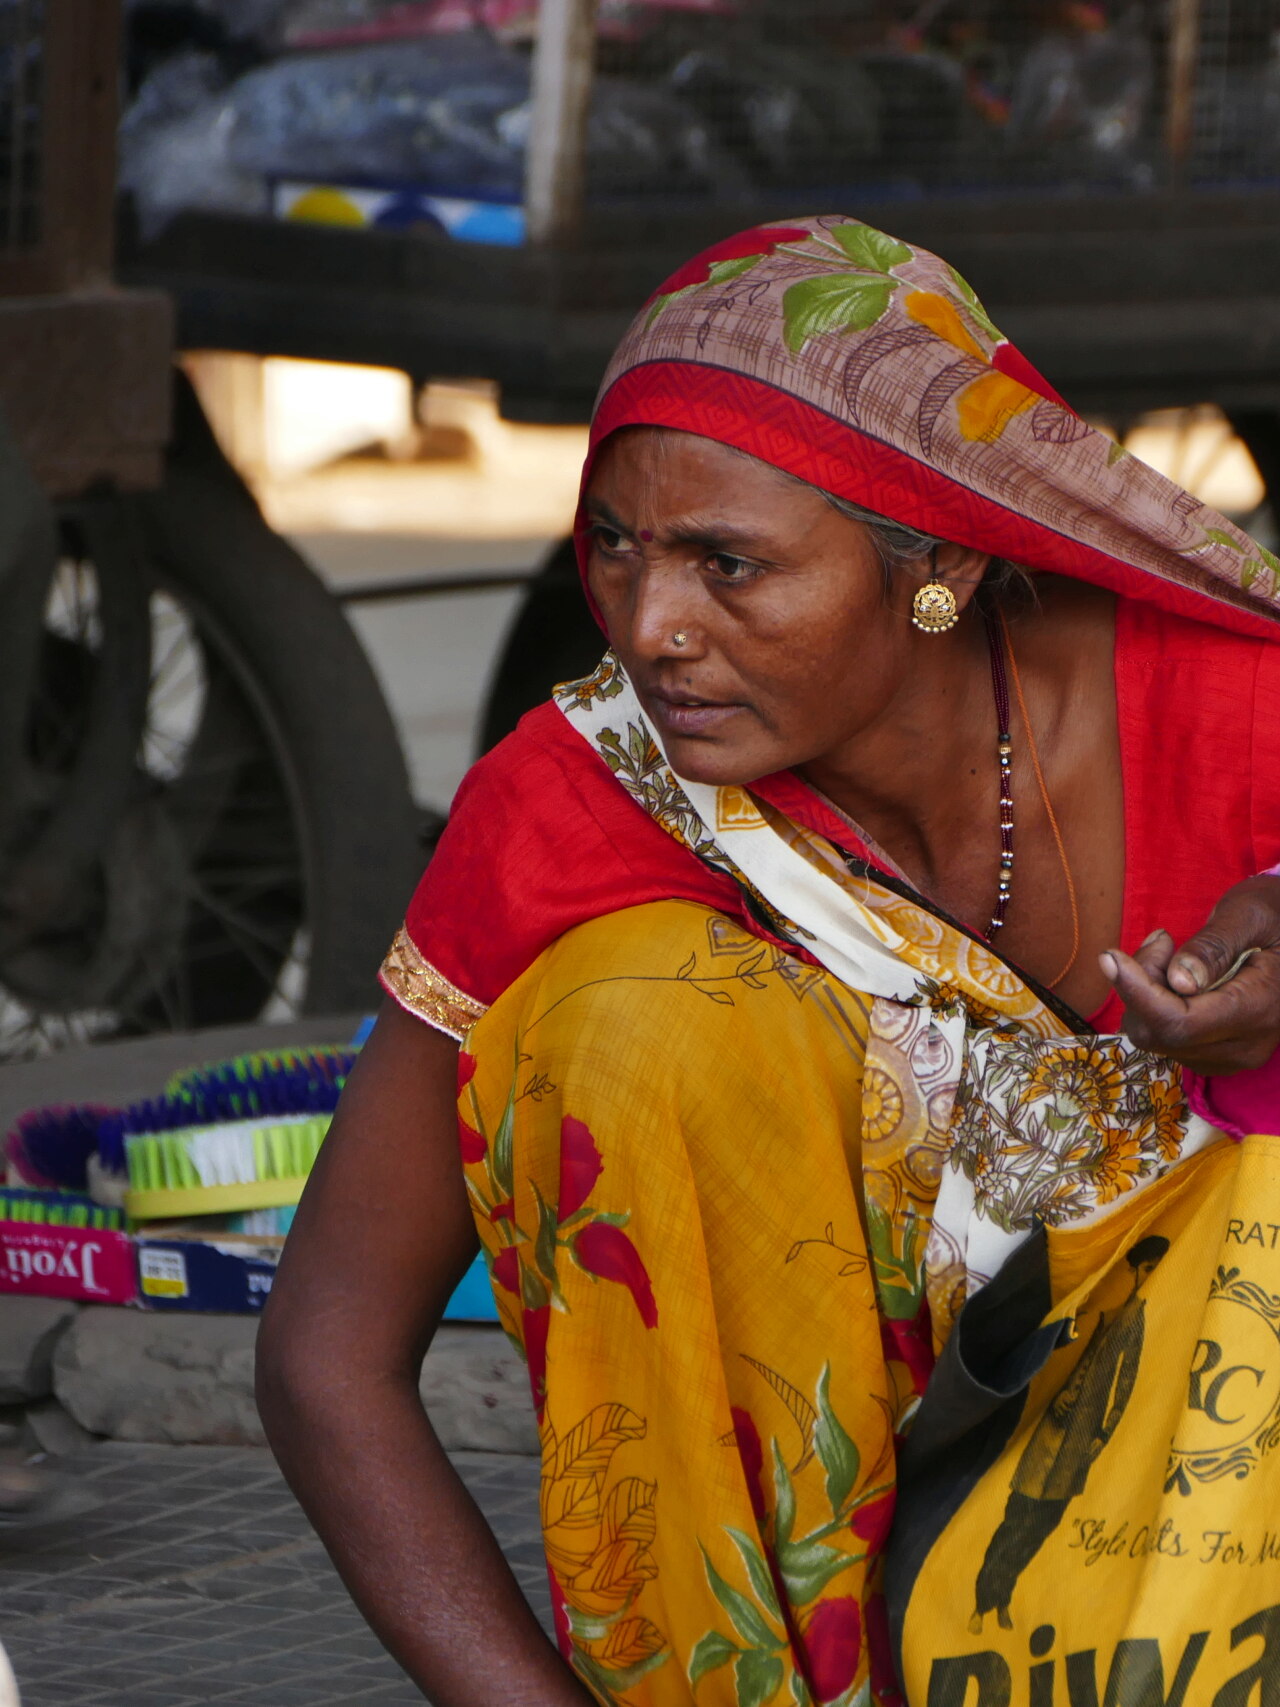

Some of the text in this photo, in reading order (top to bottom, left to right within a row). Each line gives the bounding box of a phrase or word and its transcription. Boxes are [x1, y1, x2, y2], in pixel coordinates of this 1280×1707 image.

[7, 1242, 101, 1290] Jyoti
[1188, 1339, 1266, 1425] RC
[1200, 1531, 1249, 1564] For
